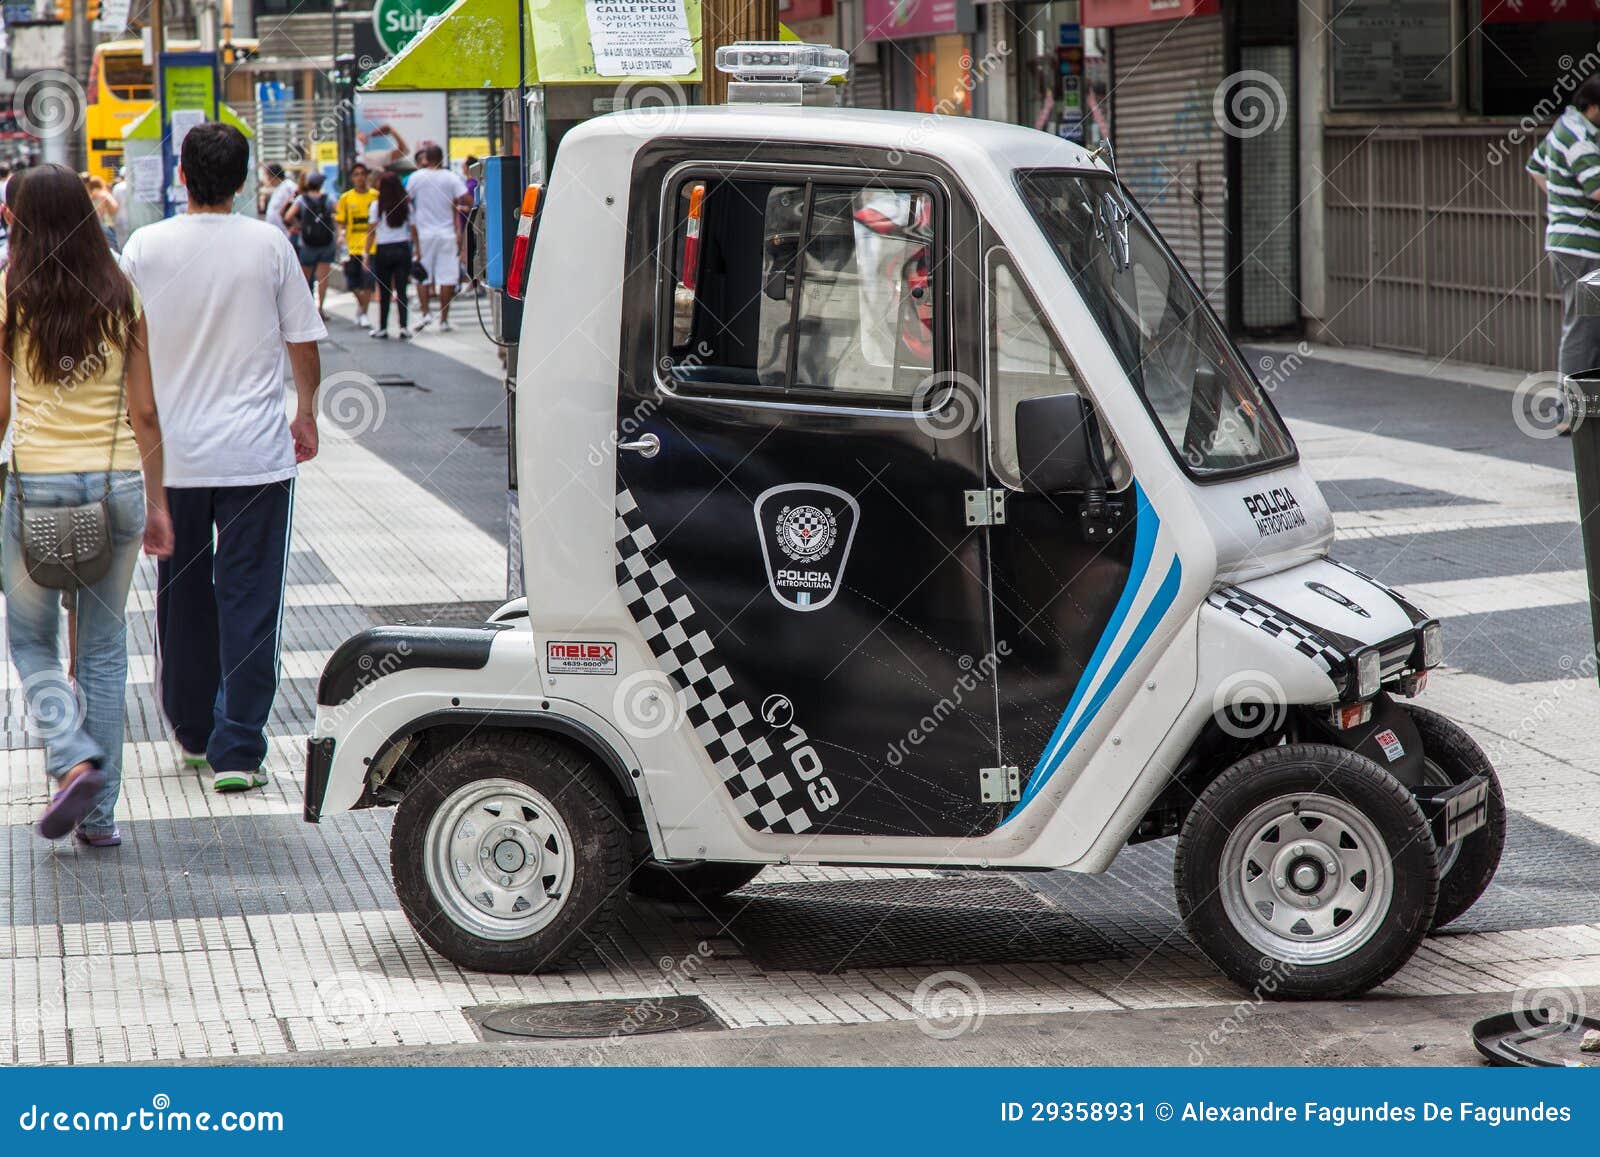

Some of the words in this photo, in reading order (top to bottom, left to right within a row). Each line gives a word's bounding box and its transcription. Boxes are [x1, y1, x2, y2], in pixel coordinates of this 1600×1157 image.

[385, 8, 425, 32] Sub
[1242, 487, 1300, 519] POLICIA
[1255, 507, 1307, 537] METROPOLITANA
[776, 580, 832, 589] METROPOLITANA
[777, 569, 832, 582] POLICIA
[550, 644, 613, 658] melex
[783, 723, 840, 812] 103
